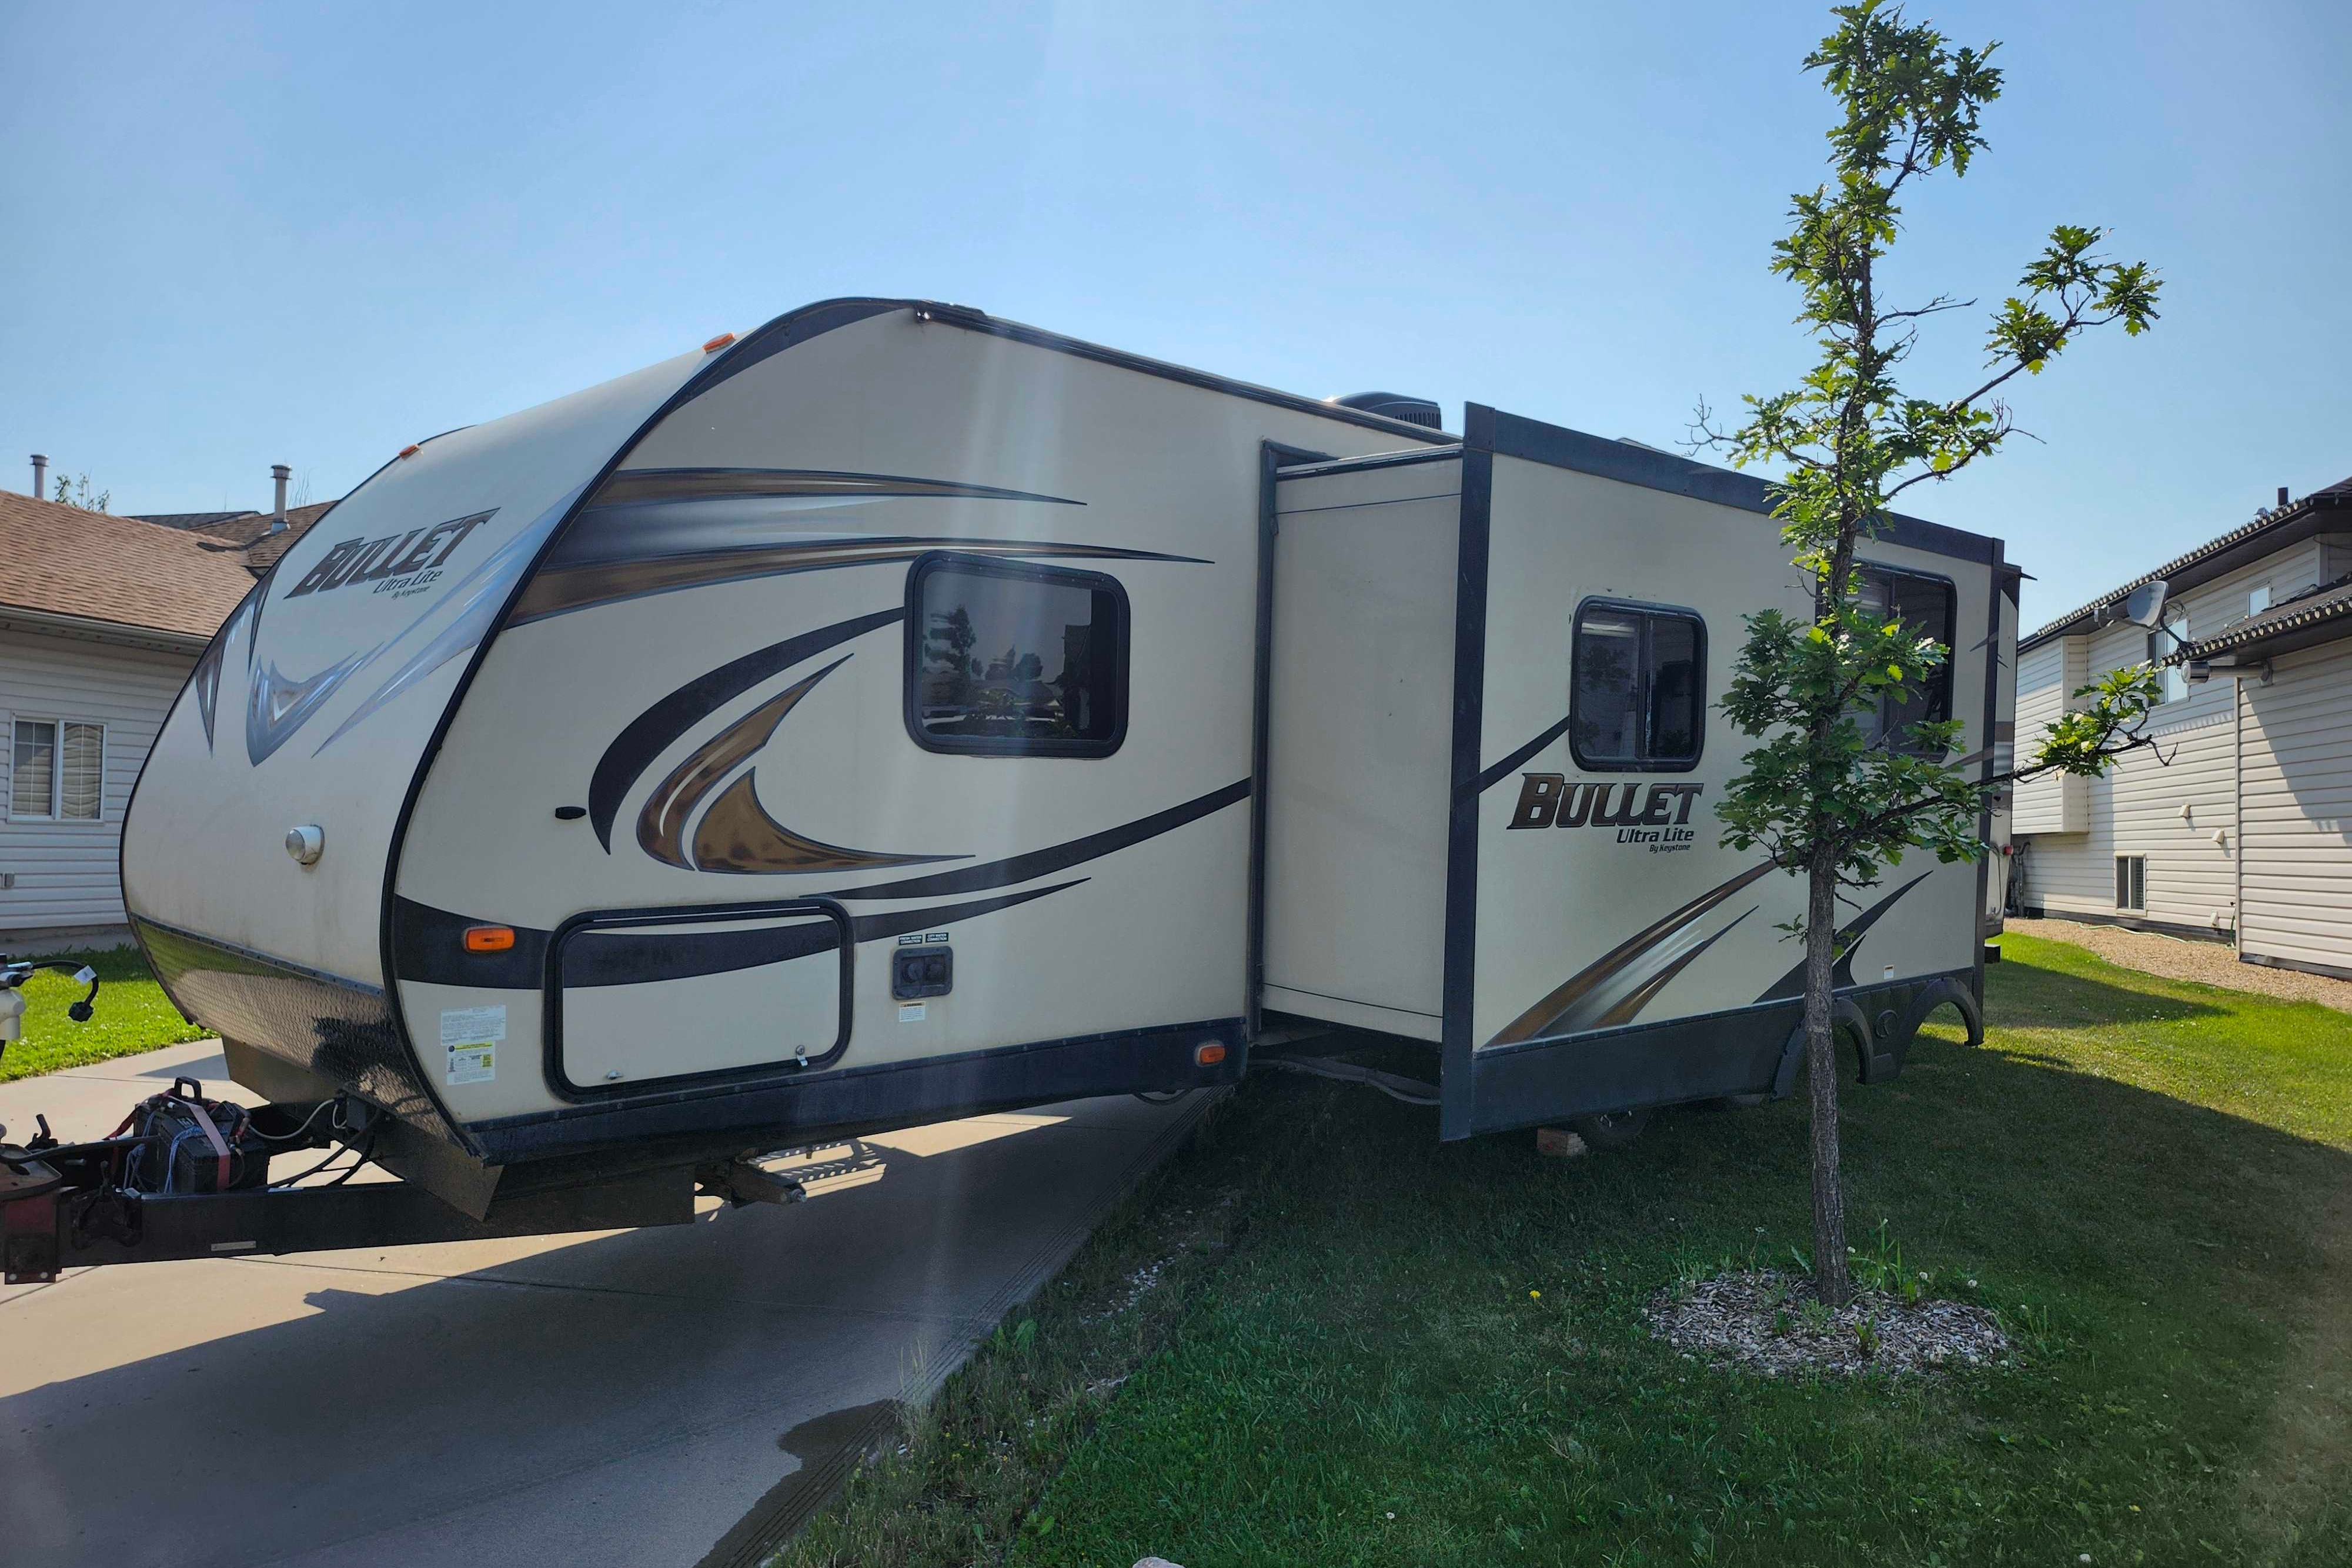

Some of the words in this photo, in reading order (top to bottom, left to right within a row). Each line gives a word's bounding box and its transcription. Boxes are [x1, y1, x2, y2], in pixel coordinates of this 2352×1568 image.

[283, 507, 501, 600] BULLET
[373, 577, 412, 594] Ultra
[410, 570, 444, 586] Lite
[1506, 773, 1705, 830] BULLET
[1616, 828, 1660, 844] Ultra
[1663, 827, 1694, 842] Lite
[1649, 844, 1659, 854] By
[1659, 844, 1690, 853] Keystone
